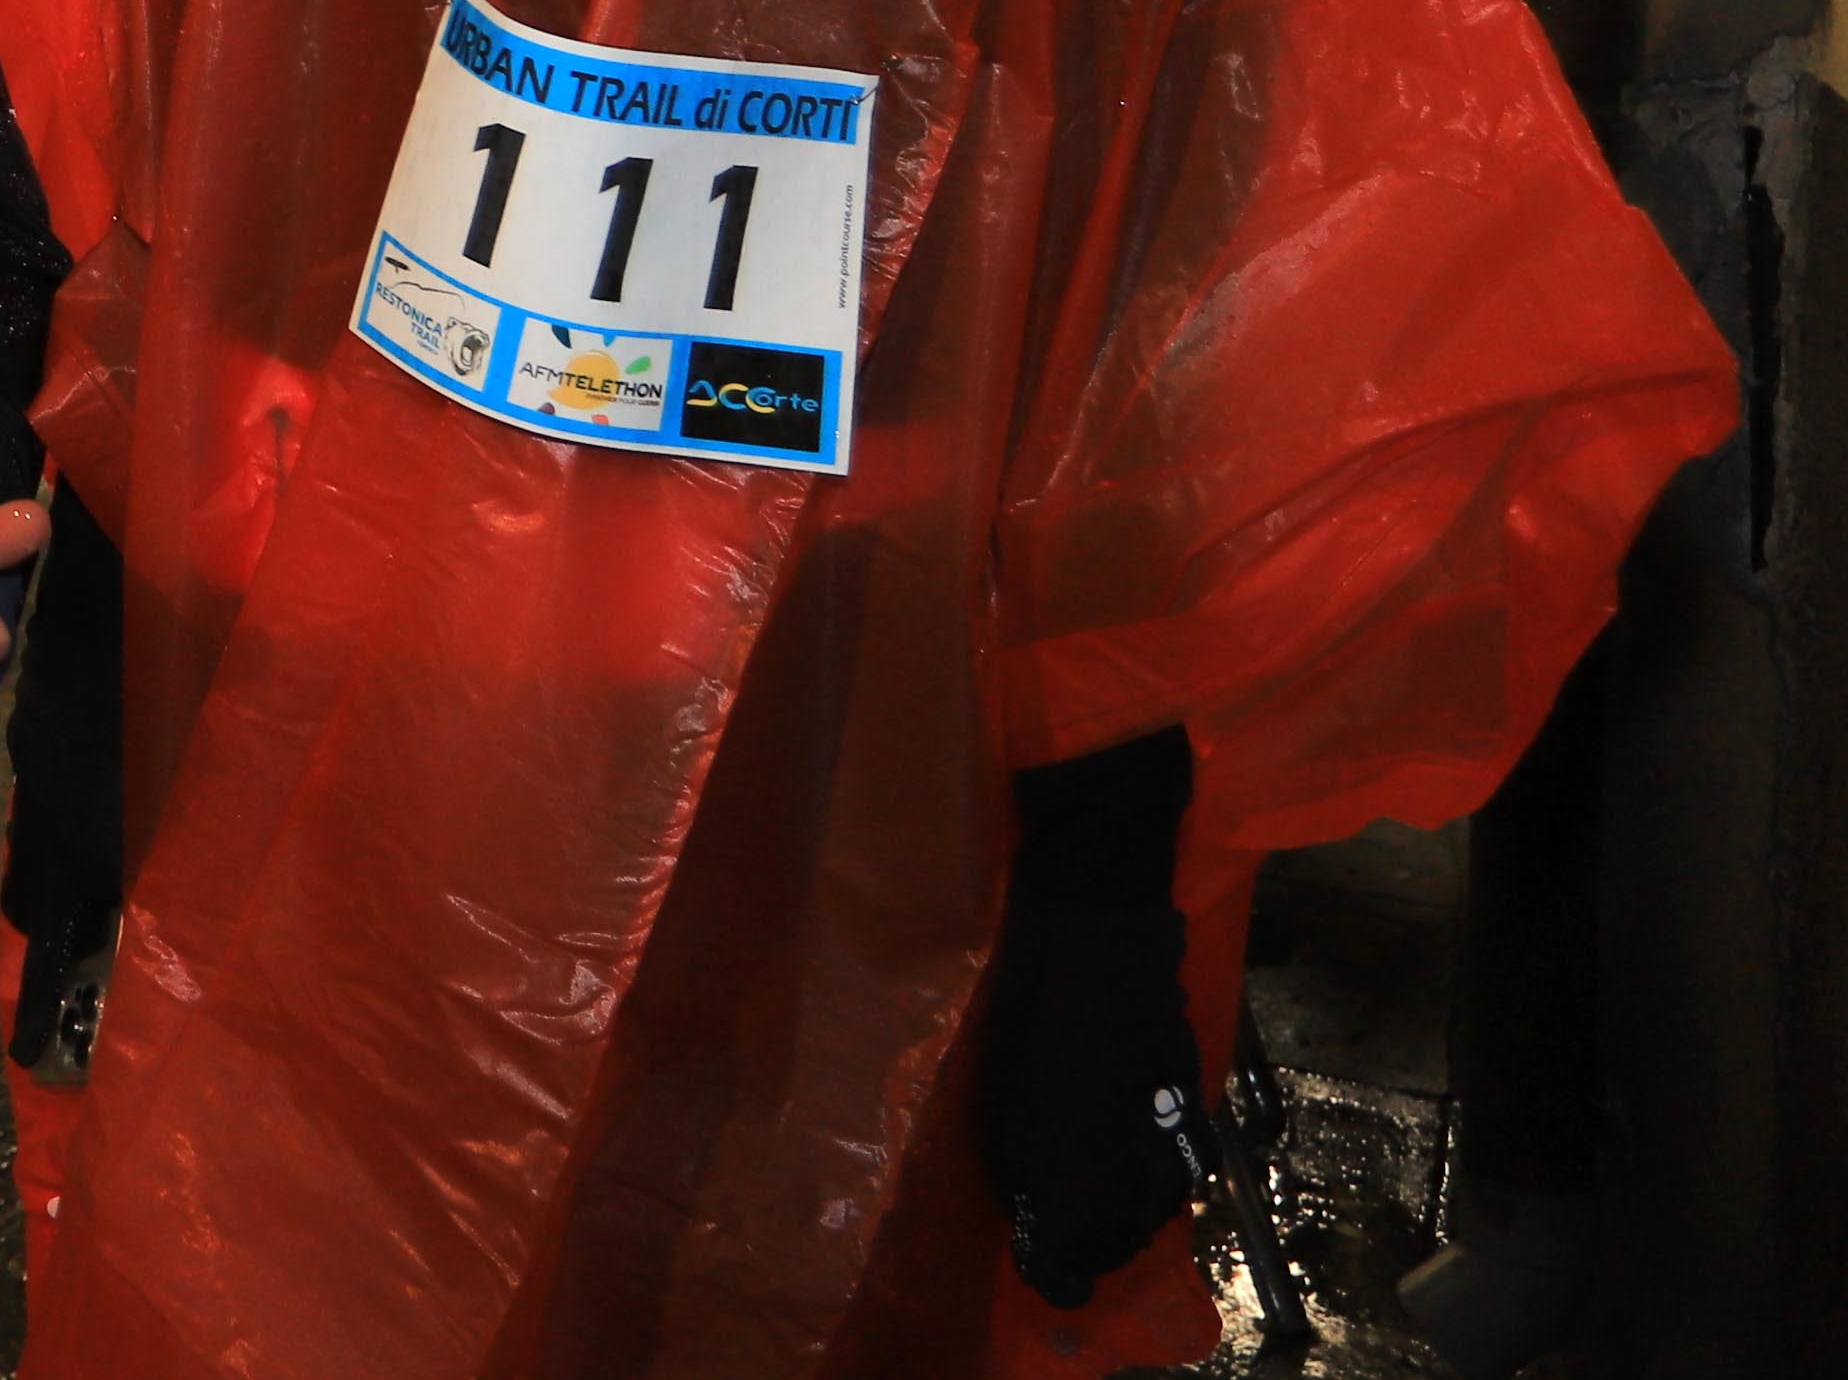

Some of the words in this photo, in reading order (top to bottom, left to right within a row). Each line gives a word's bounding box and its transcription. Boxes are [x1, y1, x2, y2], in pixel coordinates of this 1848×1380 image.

[446, 9, 555, 104] URBAN
[570, 70, 684, 127] TRAIL
[694, 88, 731, 131] di
[738, 91, 853, 141] CORTI
[838, 184, 854, 310] www.pointcourse.com
[375, 282, 443, 335] RESTONICA
[410, 322, 441, 349] TRAIL
